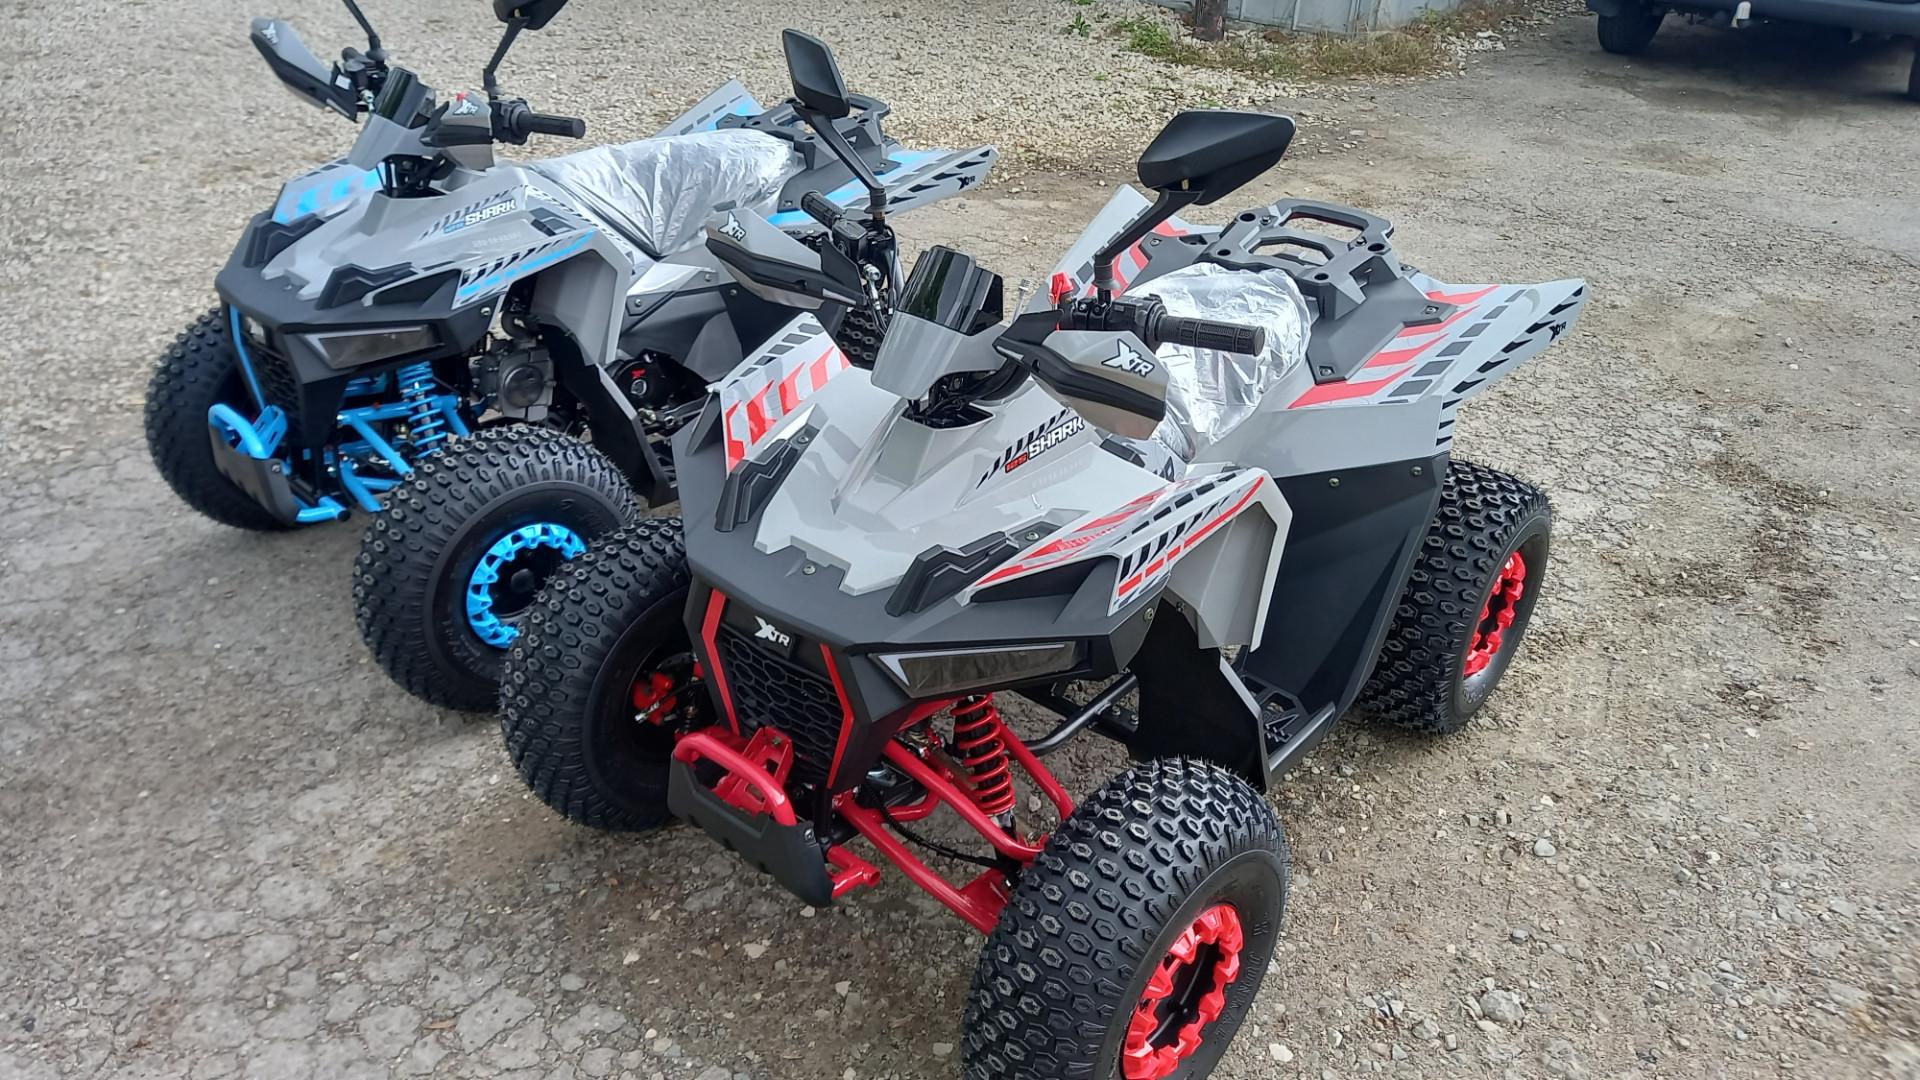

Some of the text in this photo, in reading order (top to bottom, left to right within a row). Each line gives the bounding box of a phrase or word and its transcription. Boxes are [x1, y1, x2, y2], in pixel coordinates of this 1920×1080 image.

[465, 199, 517, 226] SHARK
[718, 210, 747, 242] XTR
[1101, 338, 1155, 378] XTR
[1028, 416, 1085, 460] SHARK
[754, 615, 790, 647] XTR
